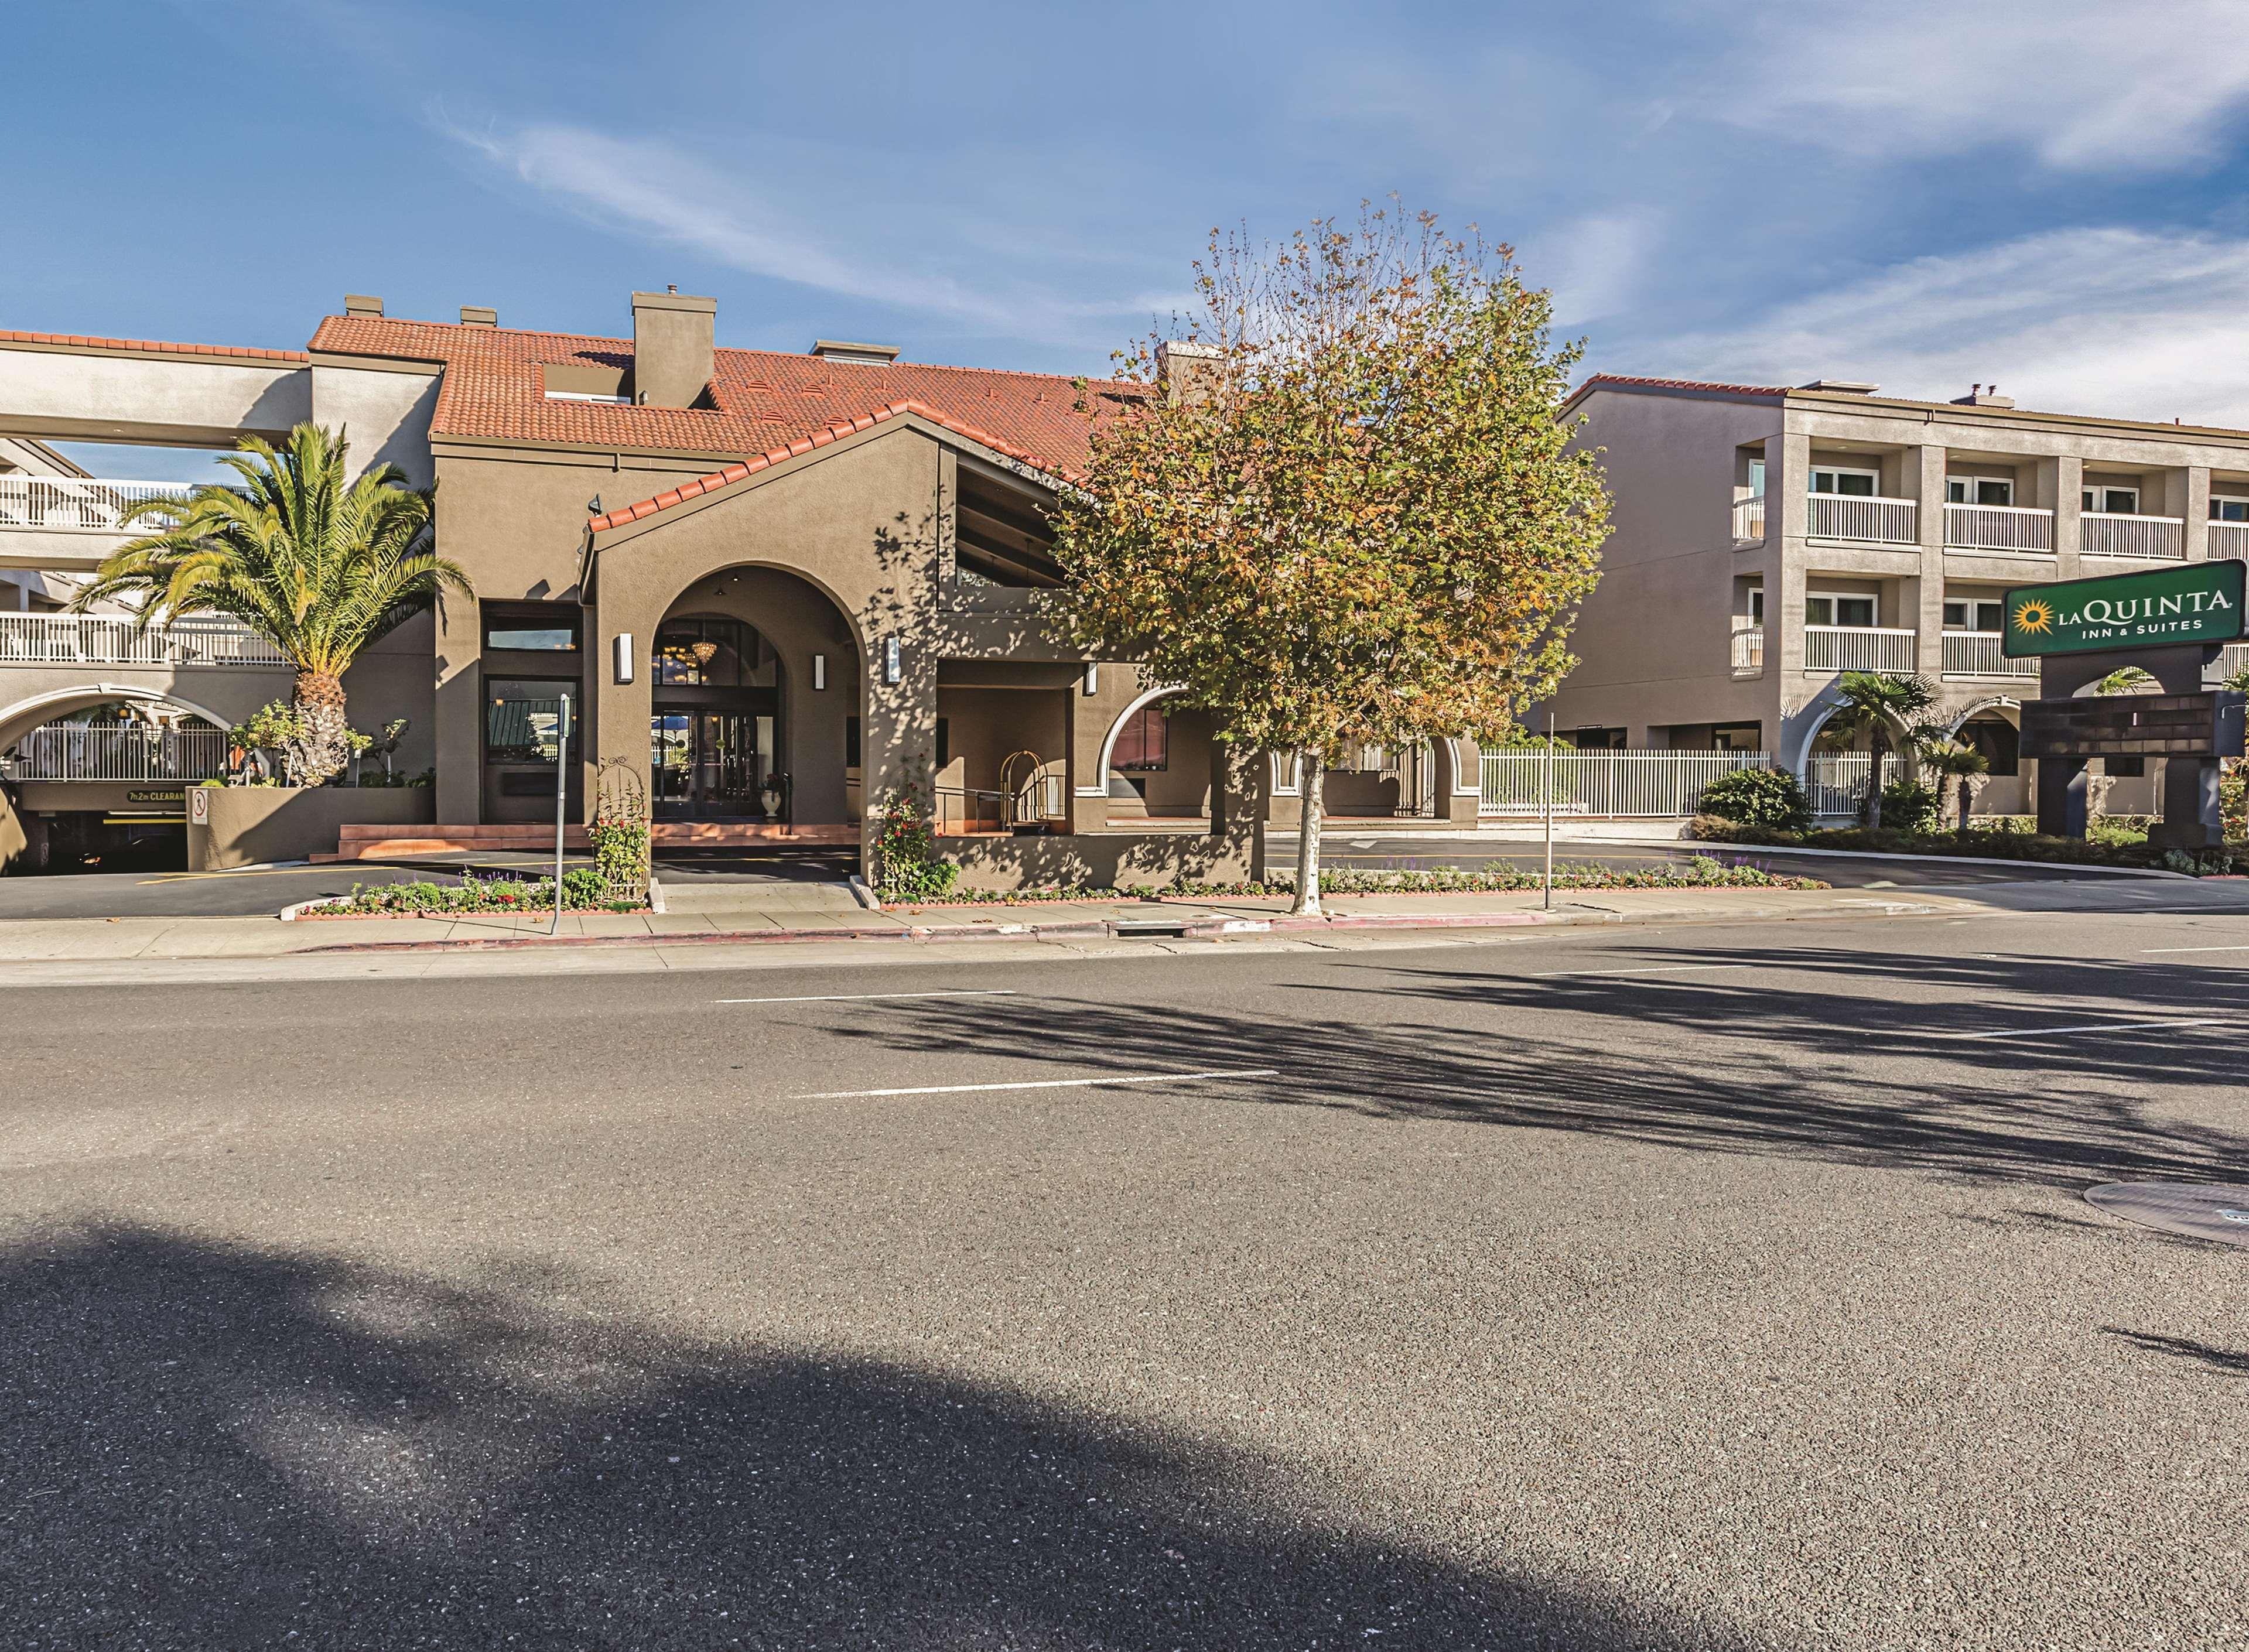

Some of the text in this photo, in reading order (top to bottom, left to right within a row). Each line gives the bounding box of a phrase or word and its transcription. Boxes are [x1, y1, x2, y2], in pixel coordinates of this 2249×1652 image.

[2083, 589, 2232, 626] QUINTA
[2081, 619, 2203, 639] INN & SUITES
[150, 792, 185, 801] CLEARAN
